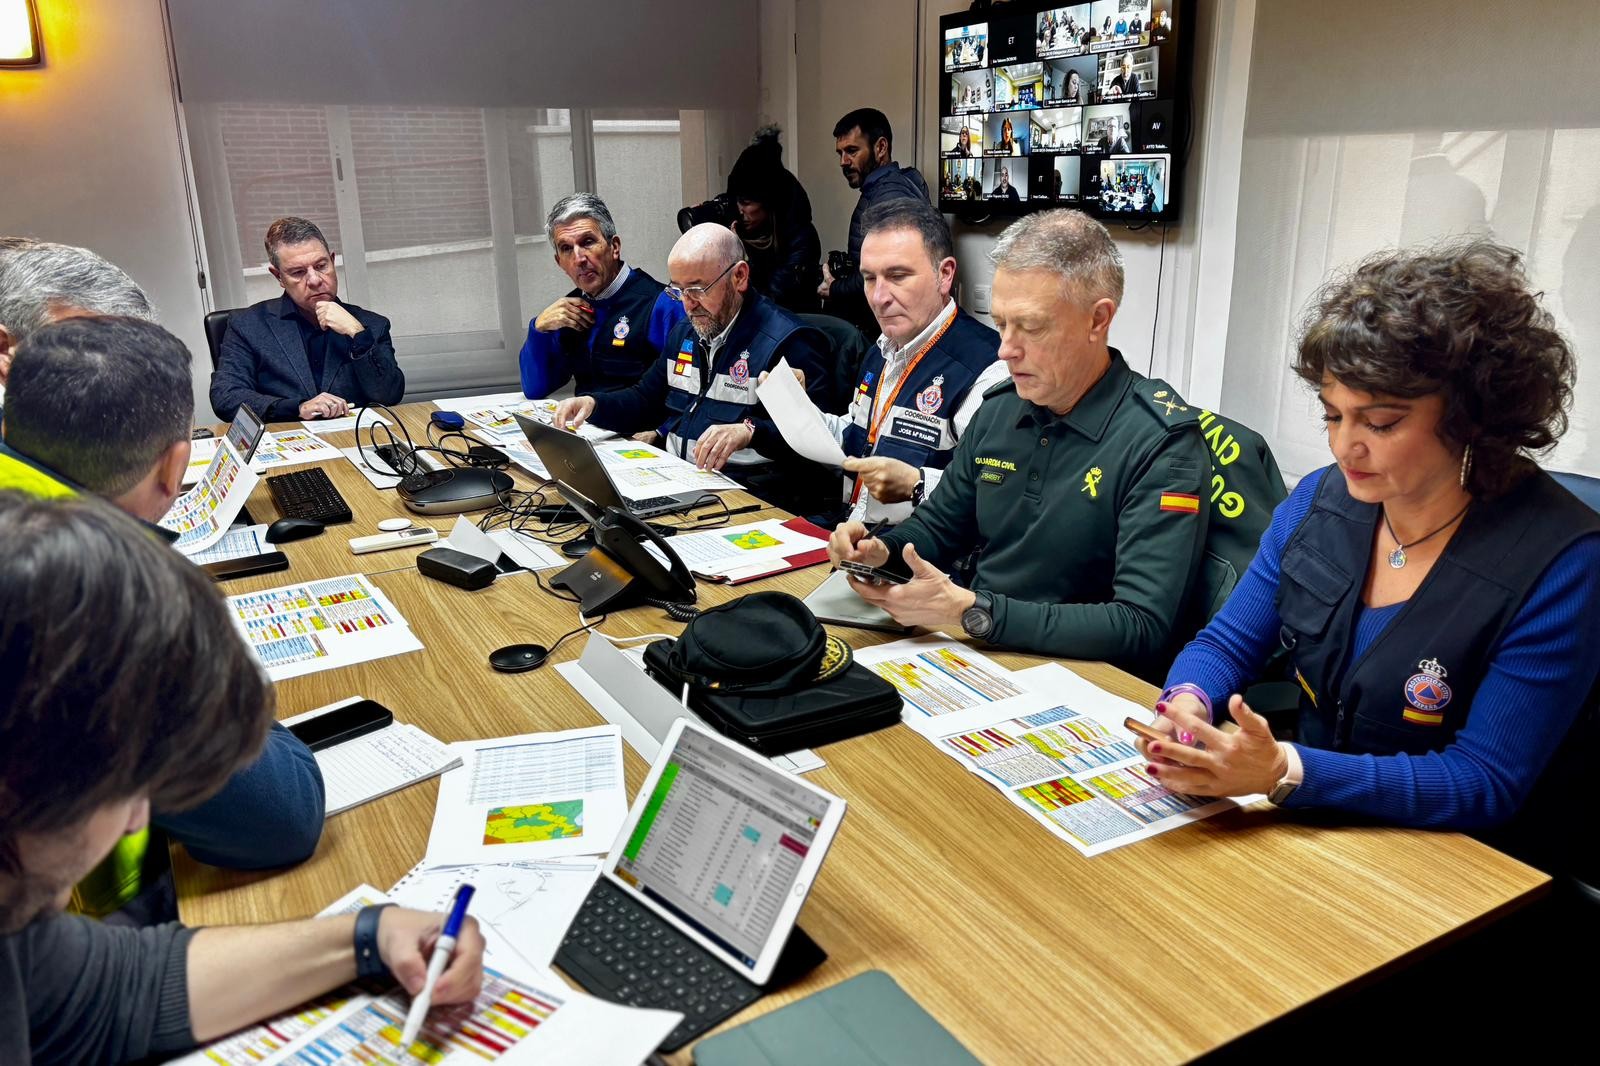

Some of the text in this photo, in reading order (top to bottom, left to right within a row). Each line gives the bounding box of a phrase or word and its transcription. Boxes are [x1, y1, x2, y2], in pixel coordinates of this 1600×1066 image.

[1152, 122, 1161, 130] AV
[975, 457, 1017, 471] GUARDIA CIVIL
